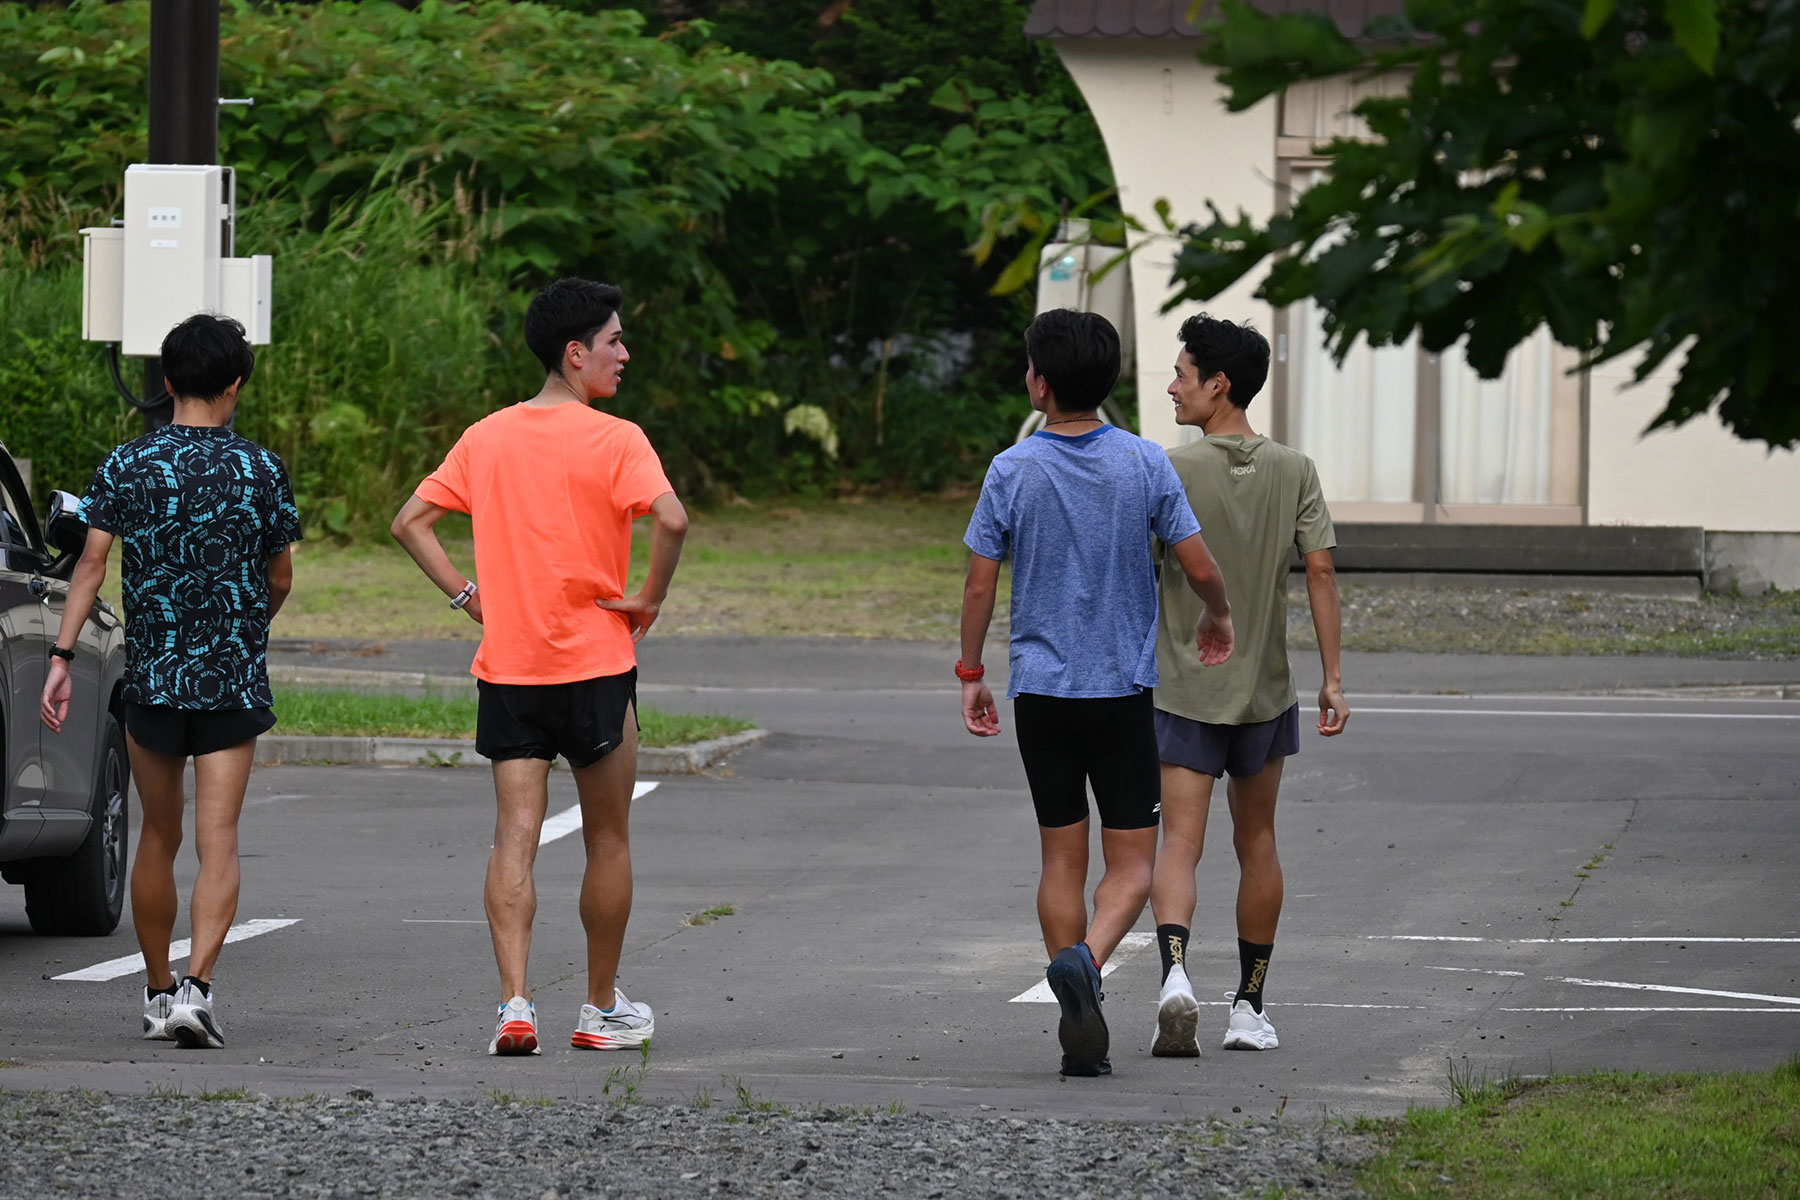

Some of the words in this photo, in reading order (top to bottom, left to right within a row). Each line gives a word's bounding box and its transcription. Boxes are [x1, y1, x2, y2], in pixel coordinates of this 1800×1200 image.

[1230, 464, 1257, 475] HOKA
[204, 537, 224, 546] REPEAT
[205, 564, 220, 572] PAIN
[221, 548, 230, 568] SWEAT
[199, 670, 219, 678] REPEAT
[216, 680, 225, 699] SWEAT
[1168, 935, 1184, 966] HOKA
[1245, 958, 1268, 993] HOKA
